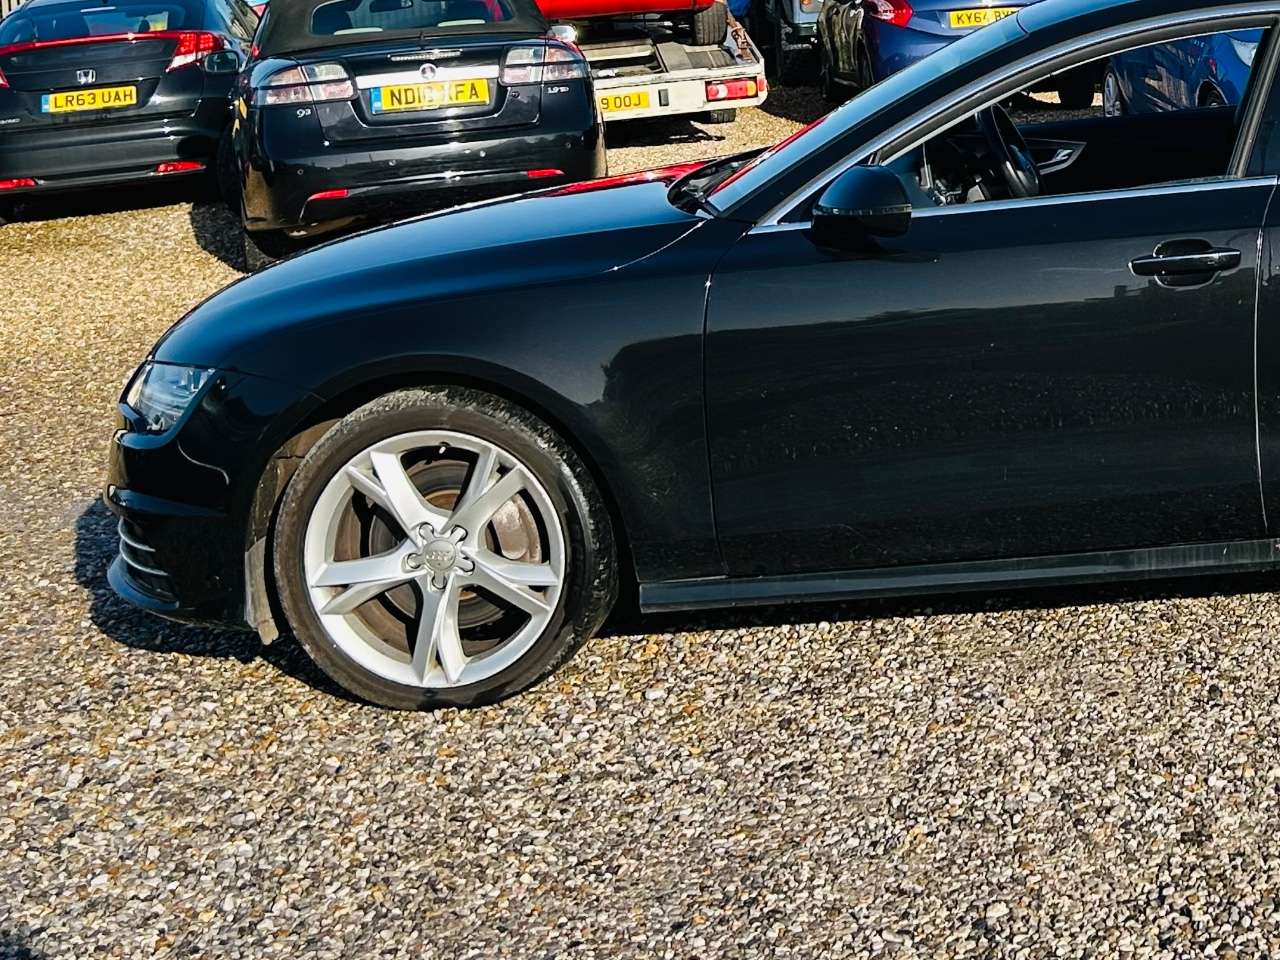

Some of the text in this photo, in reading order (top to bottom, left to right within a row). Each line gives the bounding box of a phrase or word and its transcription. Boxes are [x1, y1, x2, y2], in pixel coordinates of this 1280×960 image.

[53, 88, 133, 109] LR63 UAH
[441, 82, 479, 102] FA
